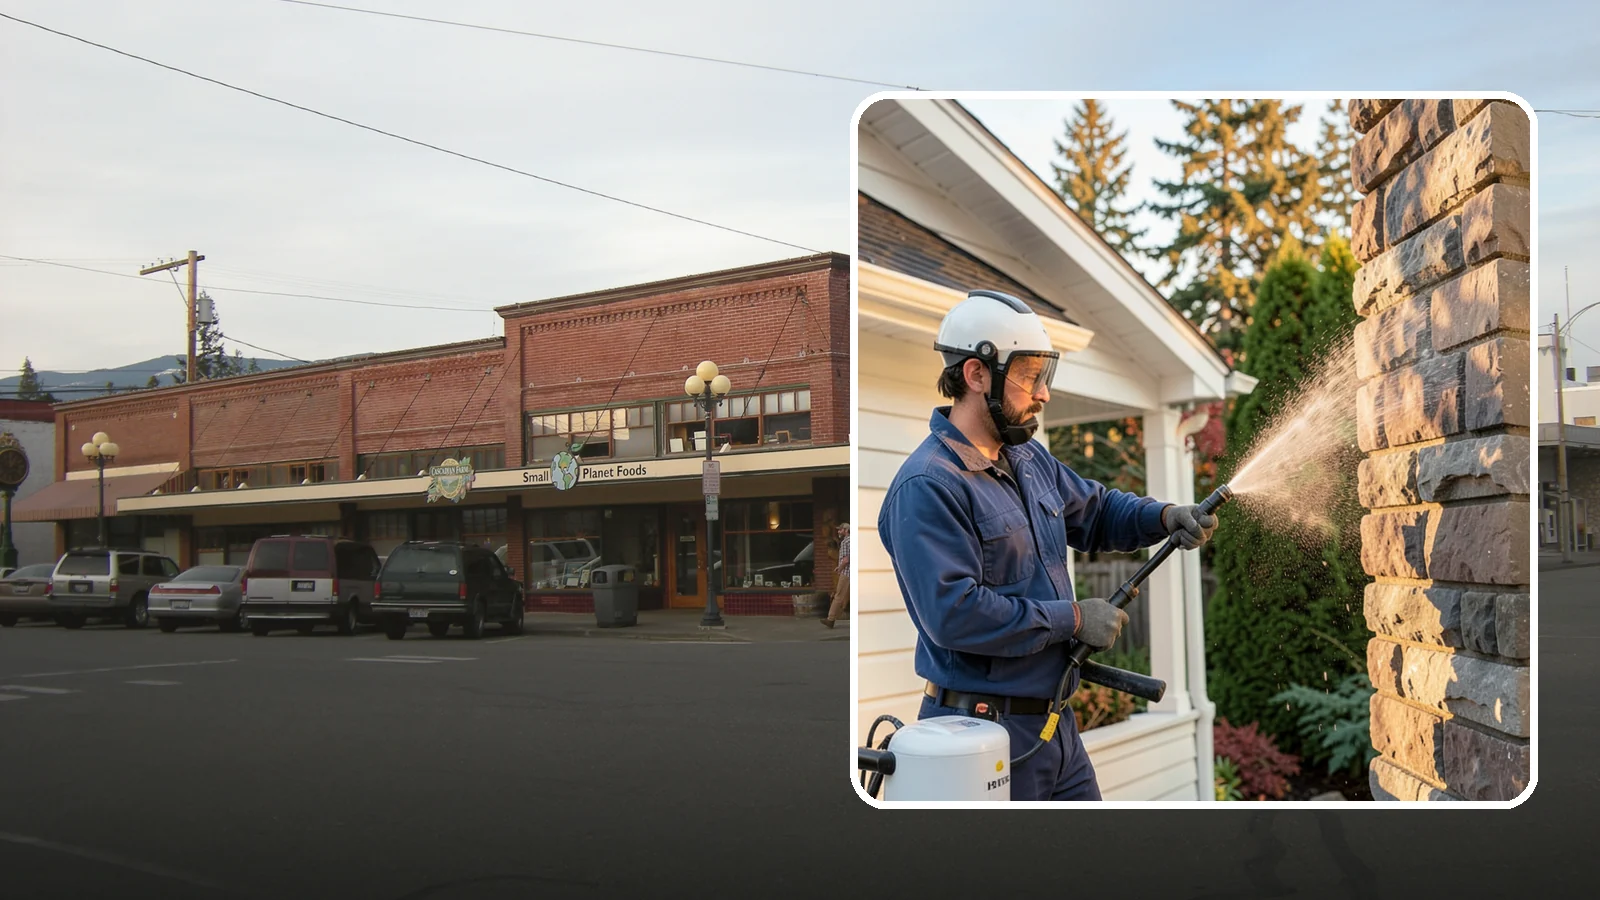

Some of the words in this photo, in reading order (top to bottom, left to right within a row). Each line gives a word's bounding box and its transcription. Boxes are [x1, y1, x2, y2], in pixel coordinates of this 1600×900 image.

[523, 470, 549, 483] Small
[582, 467, 614, 479] Planet
[616, 464, 647, 477] Foods
